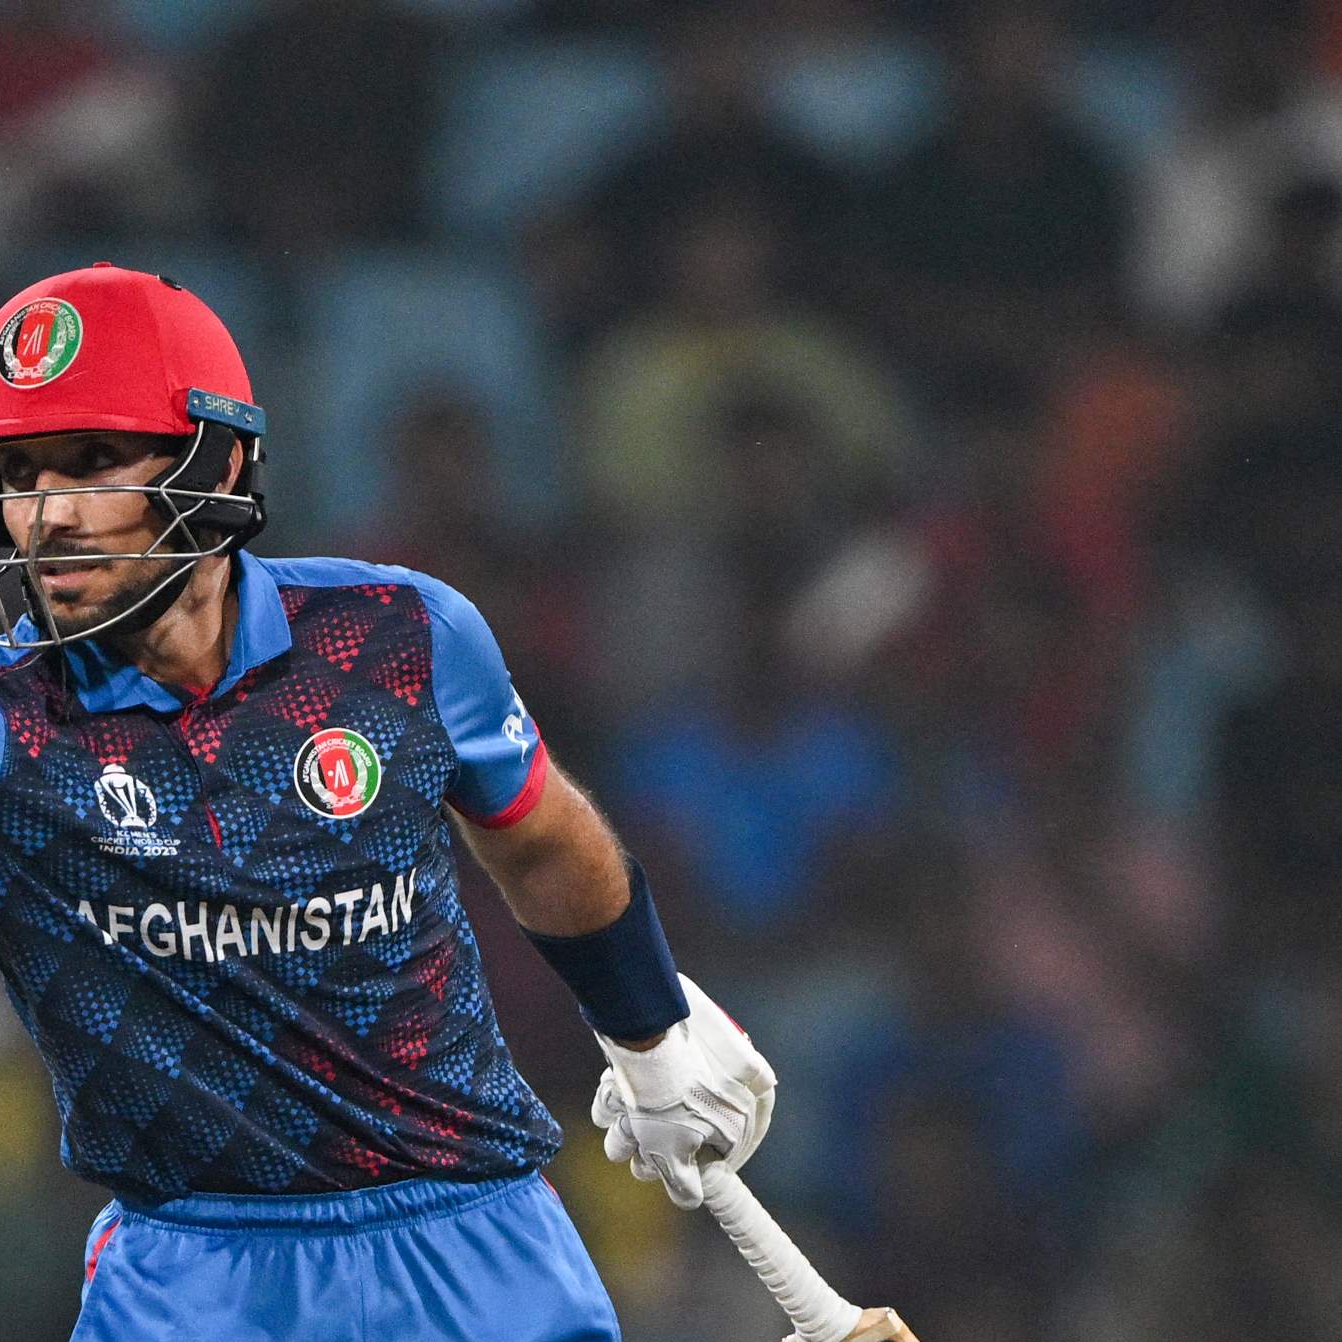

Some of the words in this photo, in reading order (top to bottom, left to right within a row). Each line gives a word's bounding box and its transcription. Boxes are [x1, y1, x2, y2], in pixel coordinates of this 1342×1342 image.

[91, 836, 130, 845] CRICKET
[131, 838, 163, 846] WORLD
[99, 845, 140, 855] INDIA
[143, 846, 178, 856] 2023
[77, 867, 416, 963] AFGHANISTAN
